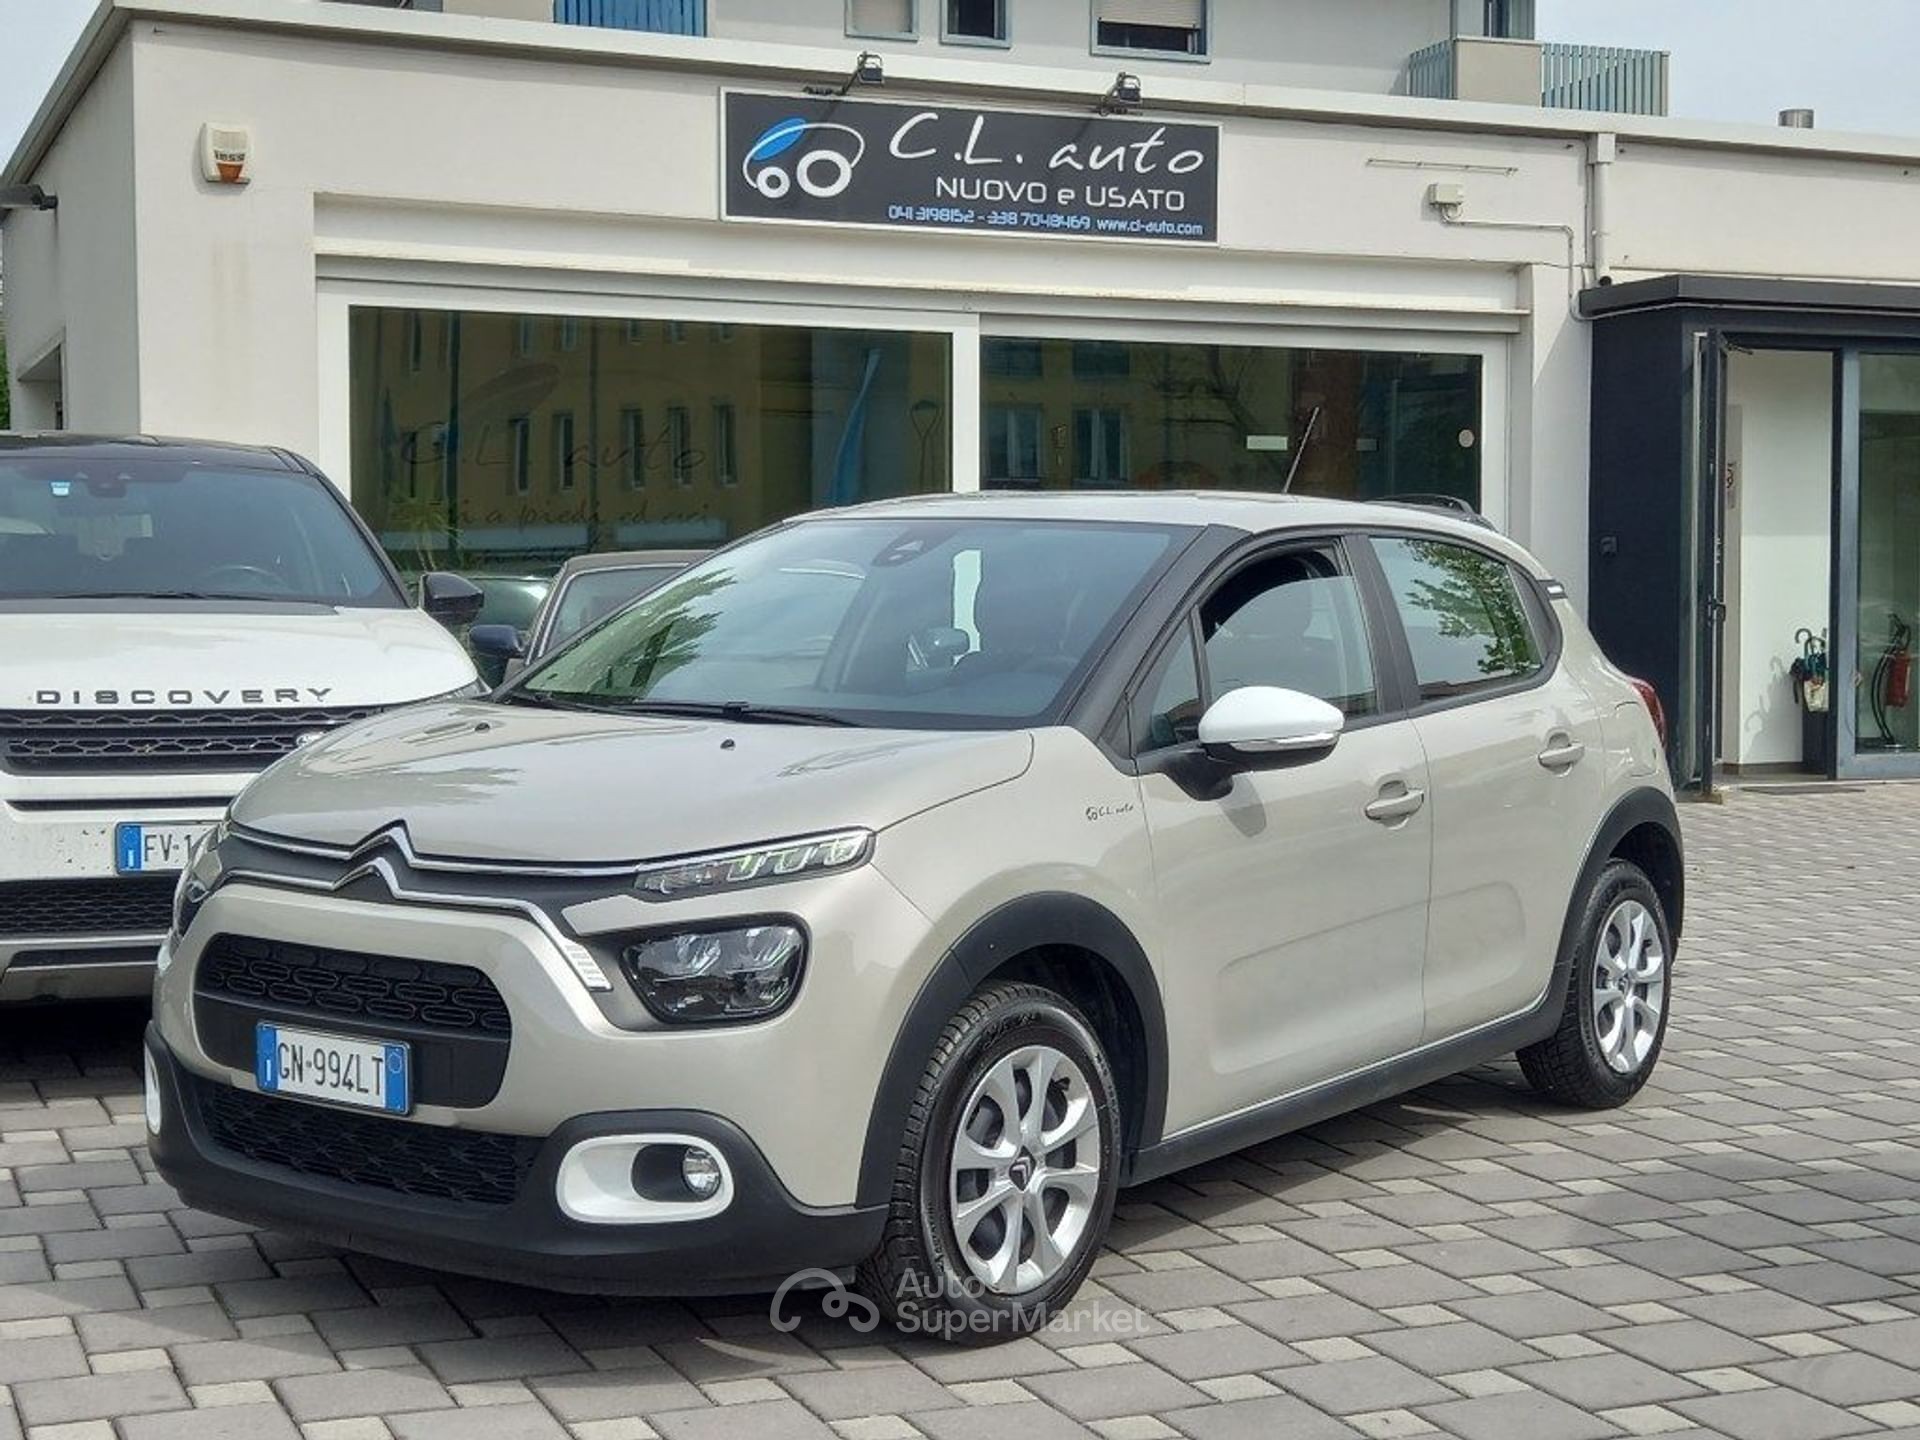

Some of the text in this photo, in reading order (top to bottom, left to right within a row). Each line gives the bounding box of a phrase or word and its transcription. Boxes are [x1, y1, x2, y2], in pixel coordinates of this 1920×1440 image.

[1049, 126, 1205, 174] auto
[935, 175, 1186, 212] NUOVO e USATO
[888, 205, 914, 220] 041
[915, 208, 975, 223] 3198152
[987, 211, 1018, 225] 338
[1020, 212, 1091, 229] 7048469
[1097, 217, 1204, 235] www.cl-auto.com
[36, 687, 332, 705] DISCOVERY
